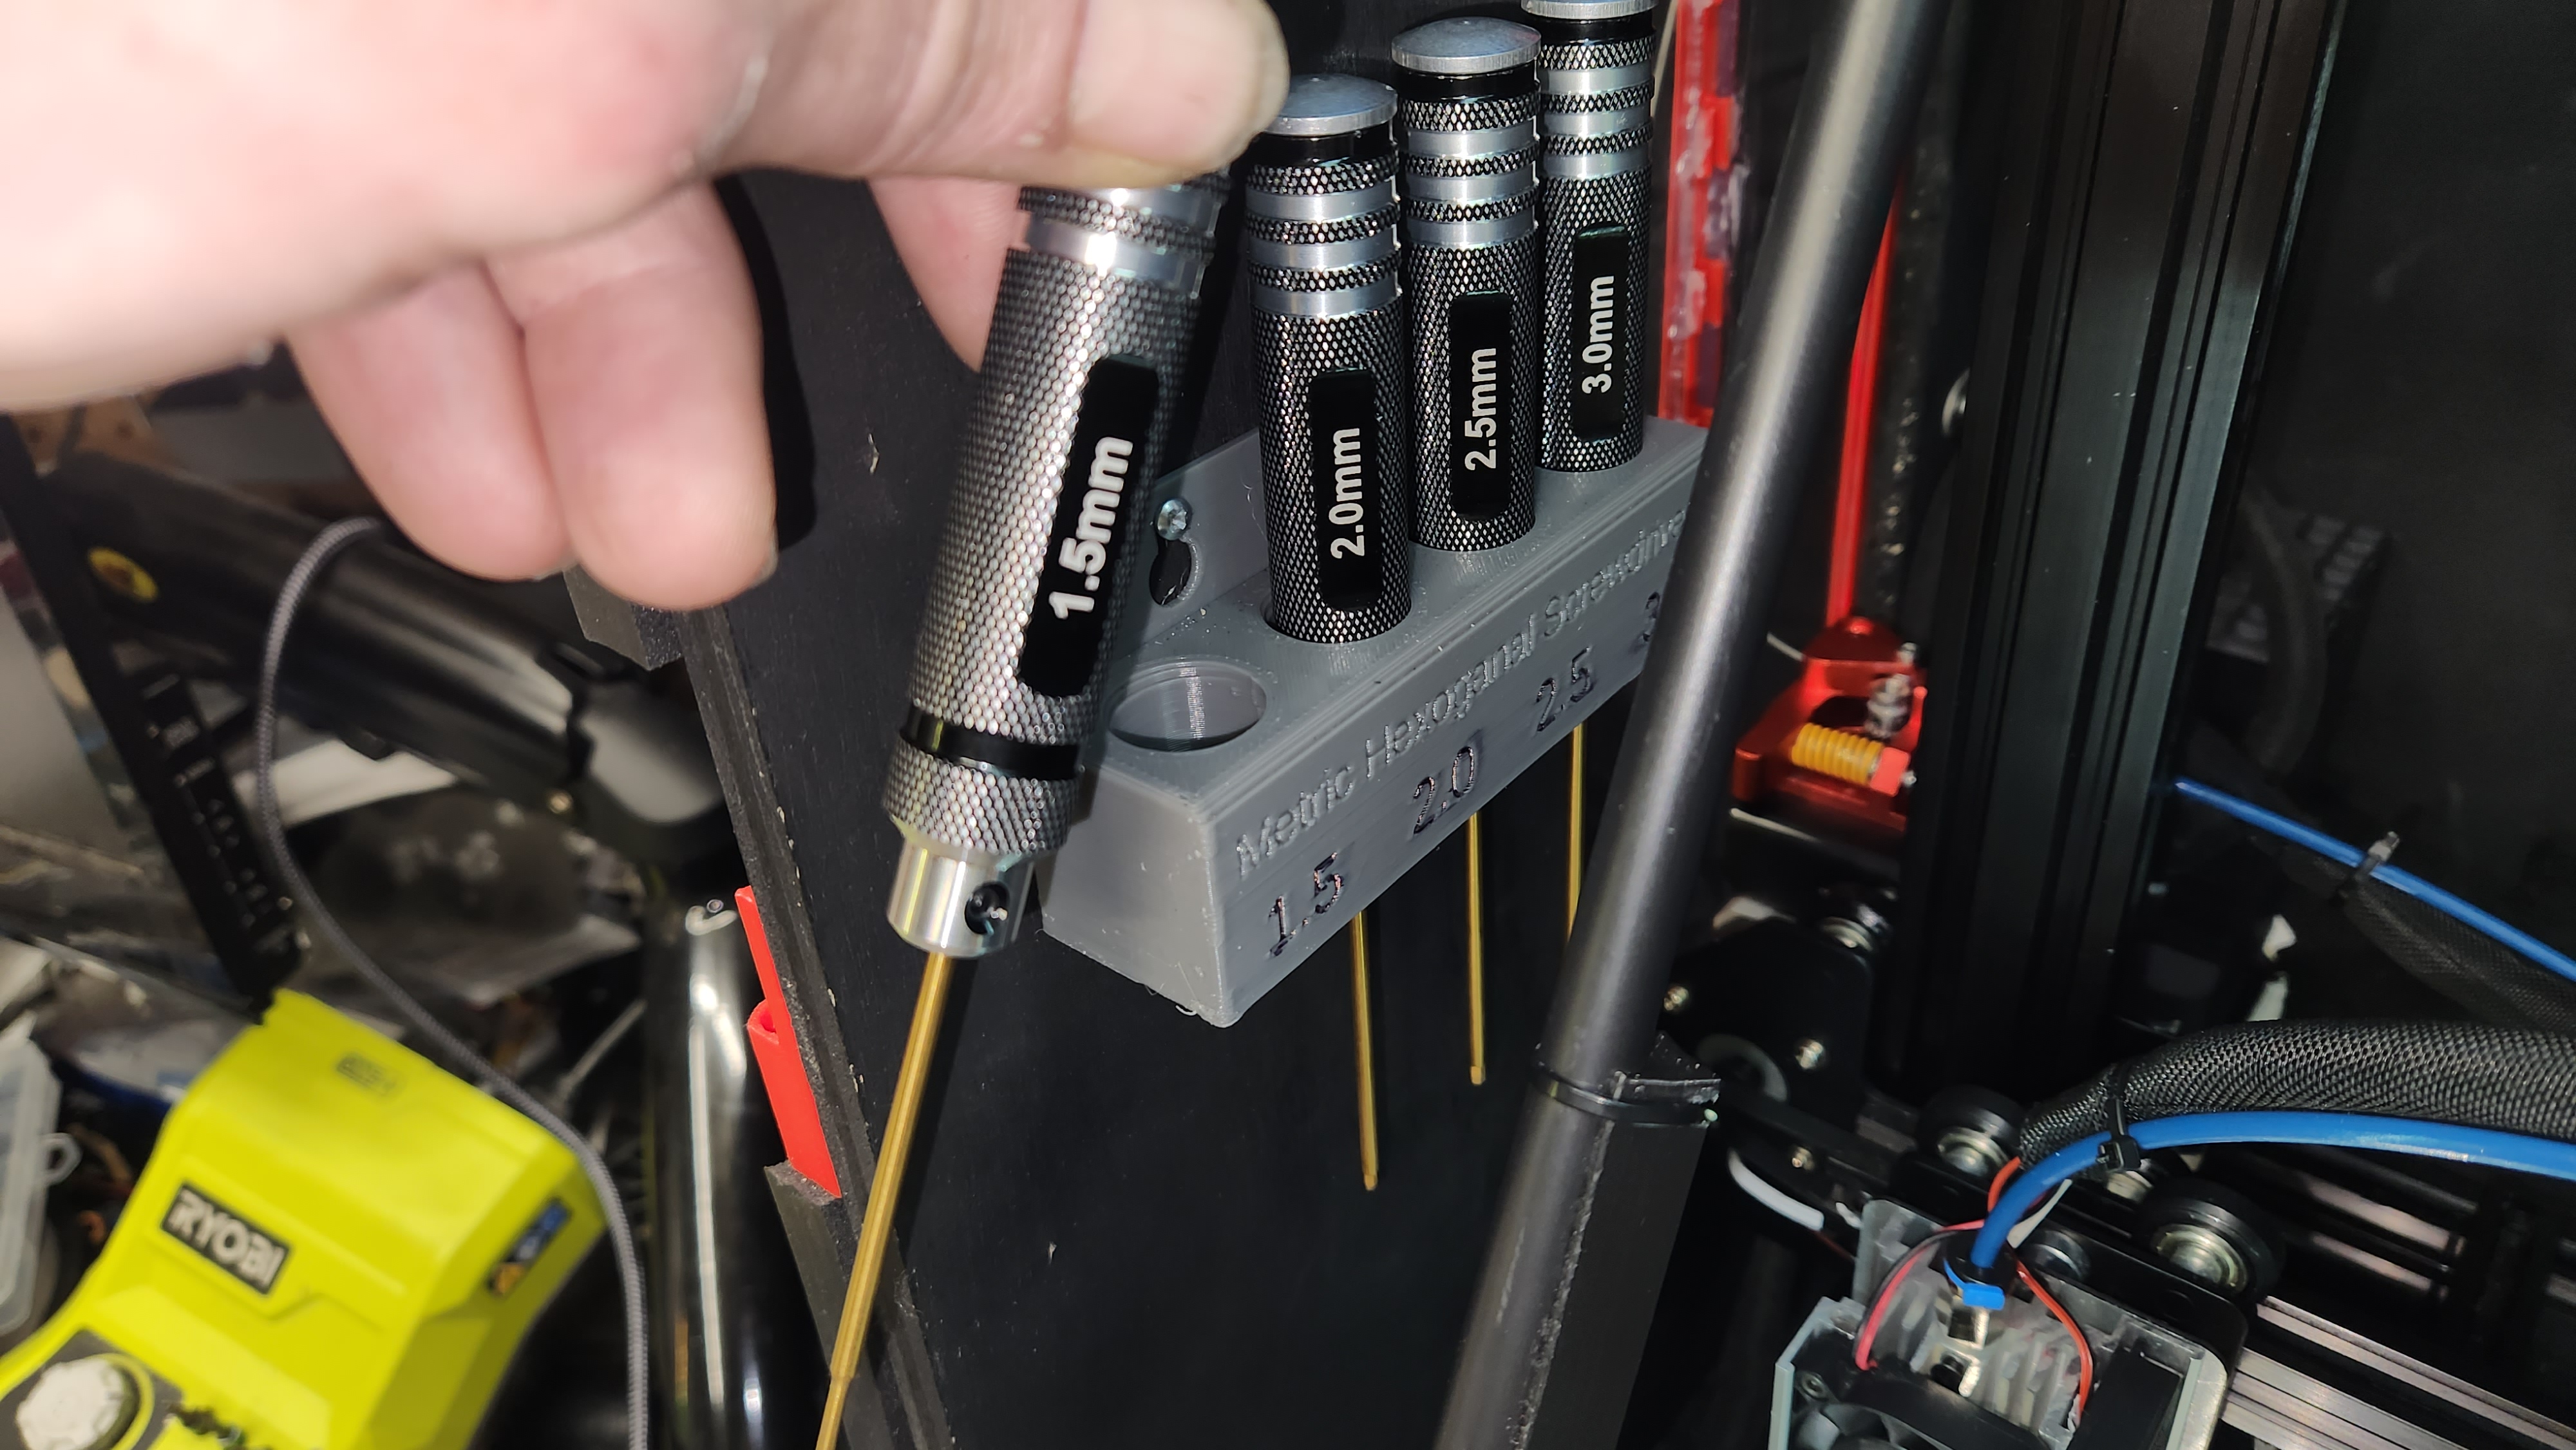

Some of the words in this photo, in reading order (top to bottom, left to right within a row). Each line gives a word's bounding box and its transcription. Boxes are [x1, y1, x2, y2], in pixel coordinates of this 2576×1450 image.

[1581, 275, 1615, 395] 3.0mm
[1464, 348, 1497, 472] 2.5mm
[1047, 435, 1134, 621] 1.5mm
[1328, 428, 1366, 560] 2.0mm
[1642, 591, 1662, 644] 3
[1235, 764, 1354, 878] Metric
[1365, 612, 1537, 778] Hexoganal
[1544, 509, 1687, 638] Screwdrive
[1536, 646, 1595, 732] 2.5
[1412, 745, 1477, 835] 2.0
[1268, 851, 1345, 958] 1.5
[166, 1188, 287, 1288] RYOBI
